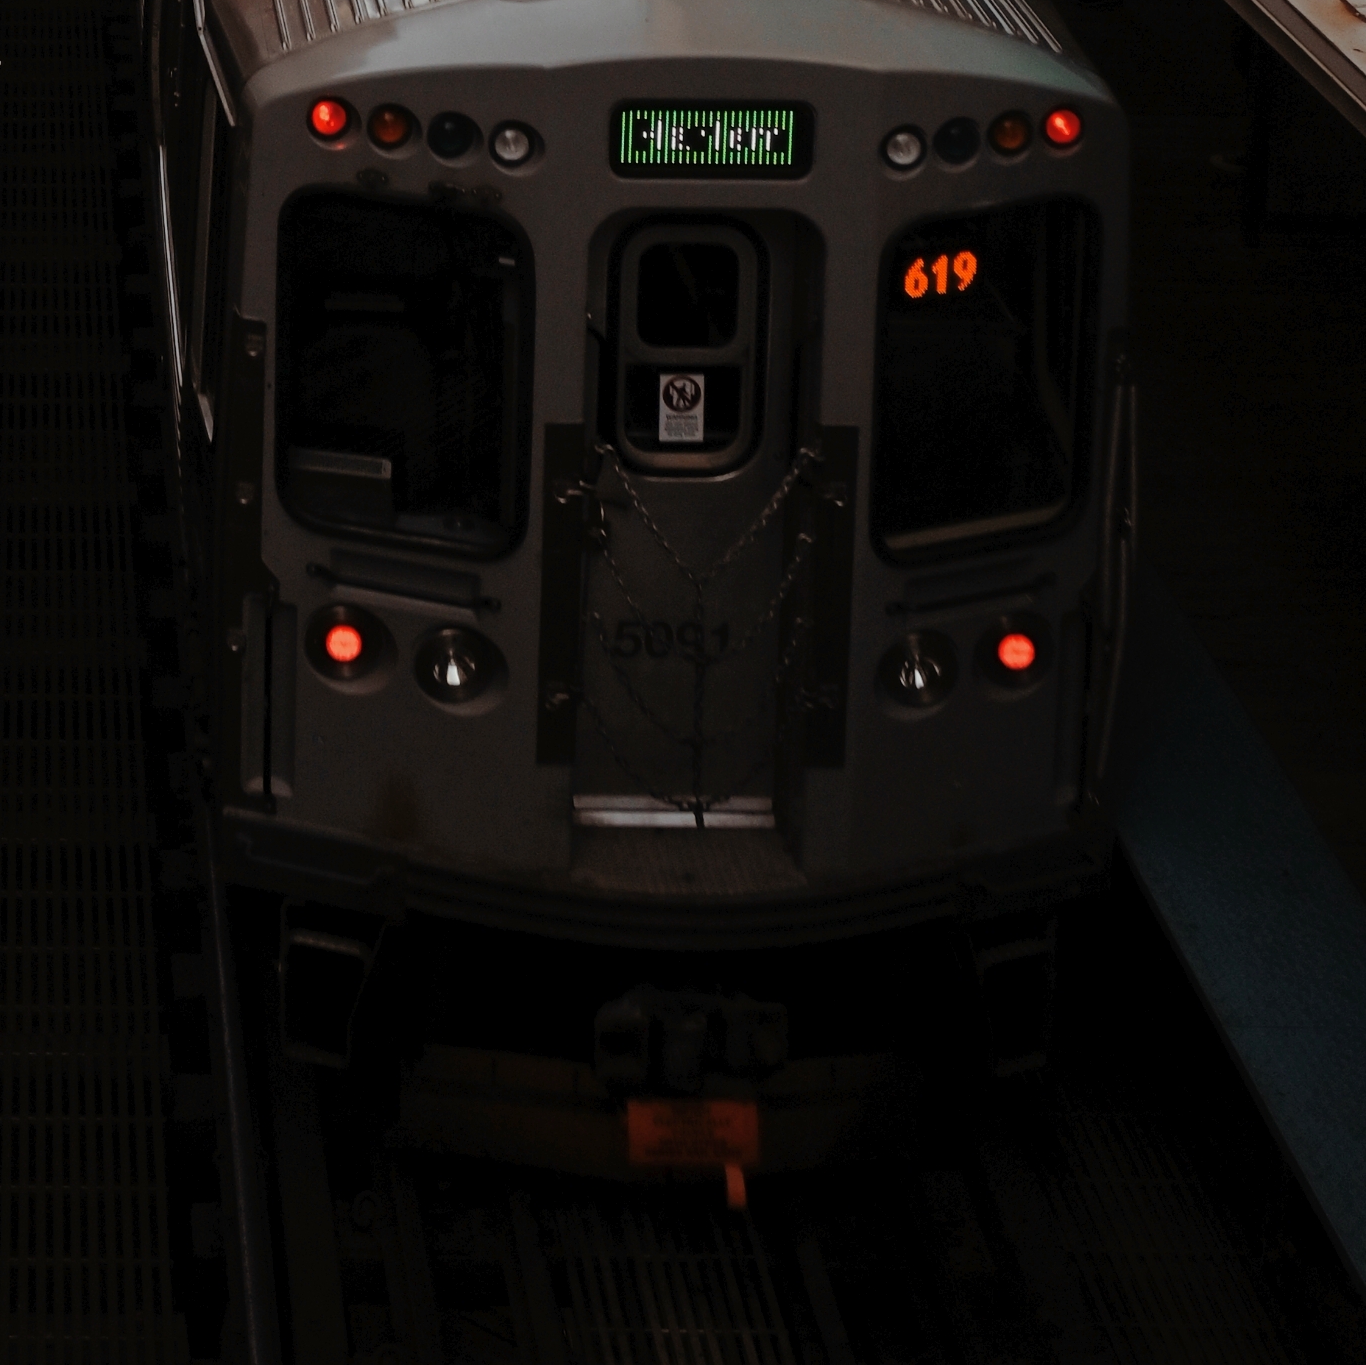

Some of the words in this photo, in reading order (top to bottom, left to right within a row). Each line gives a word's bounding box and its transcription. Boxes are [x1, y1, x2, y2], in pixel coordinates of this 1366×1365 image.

[637, 119, 784, 152] Halem
[905, 251, 977, 298] 619
[610, 622, 730, 658] 5091
